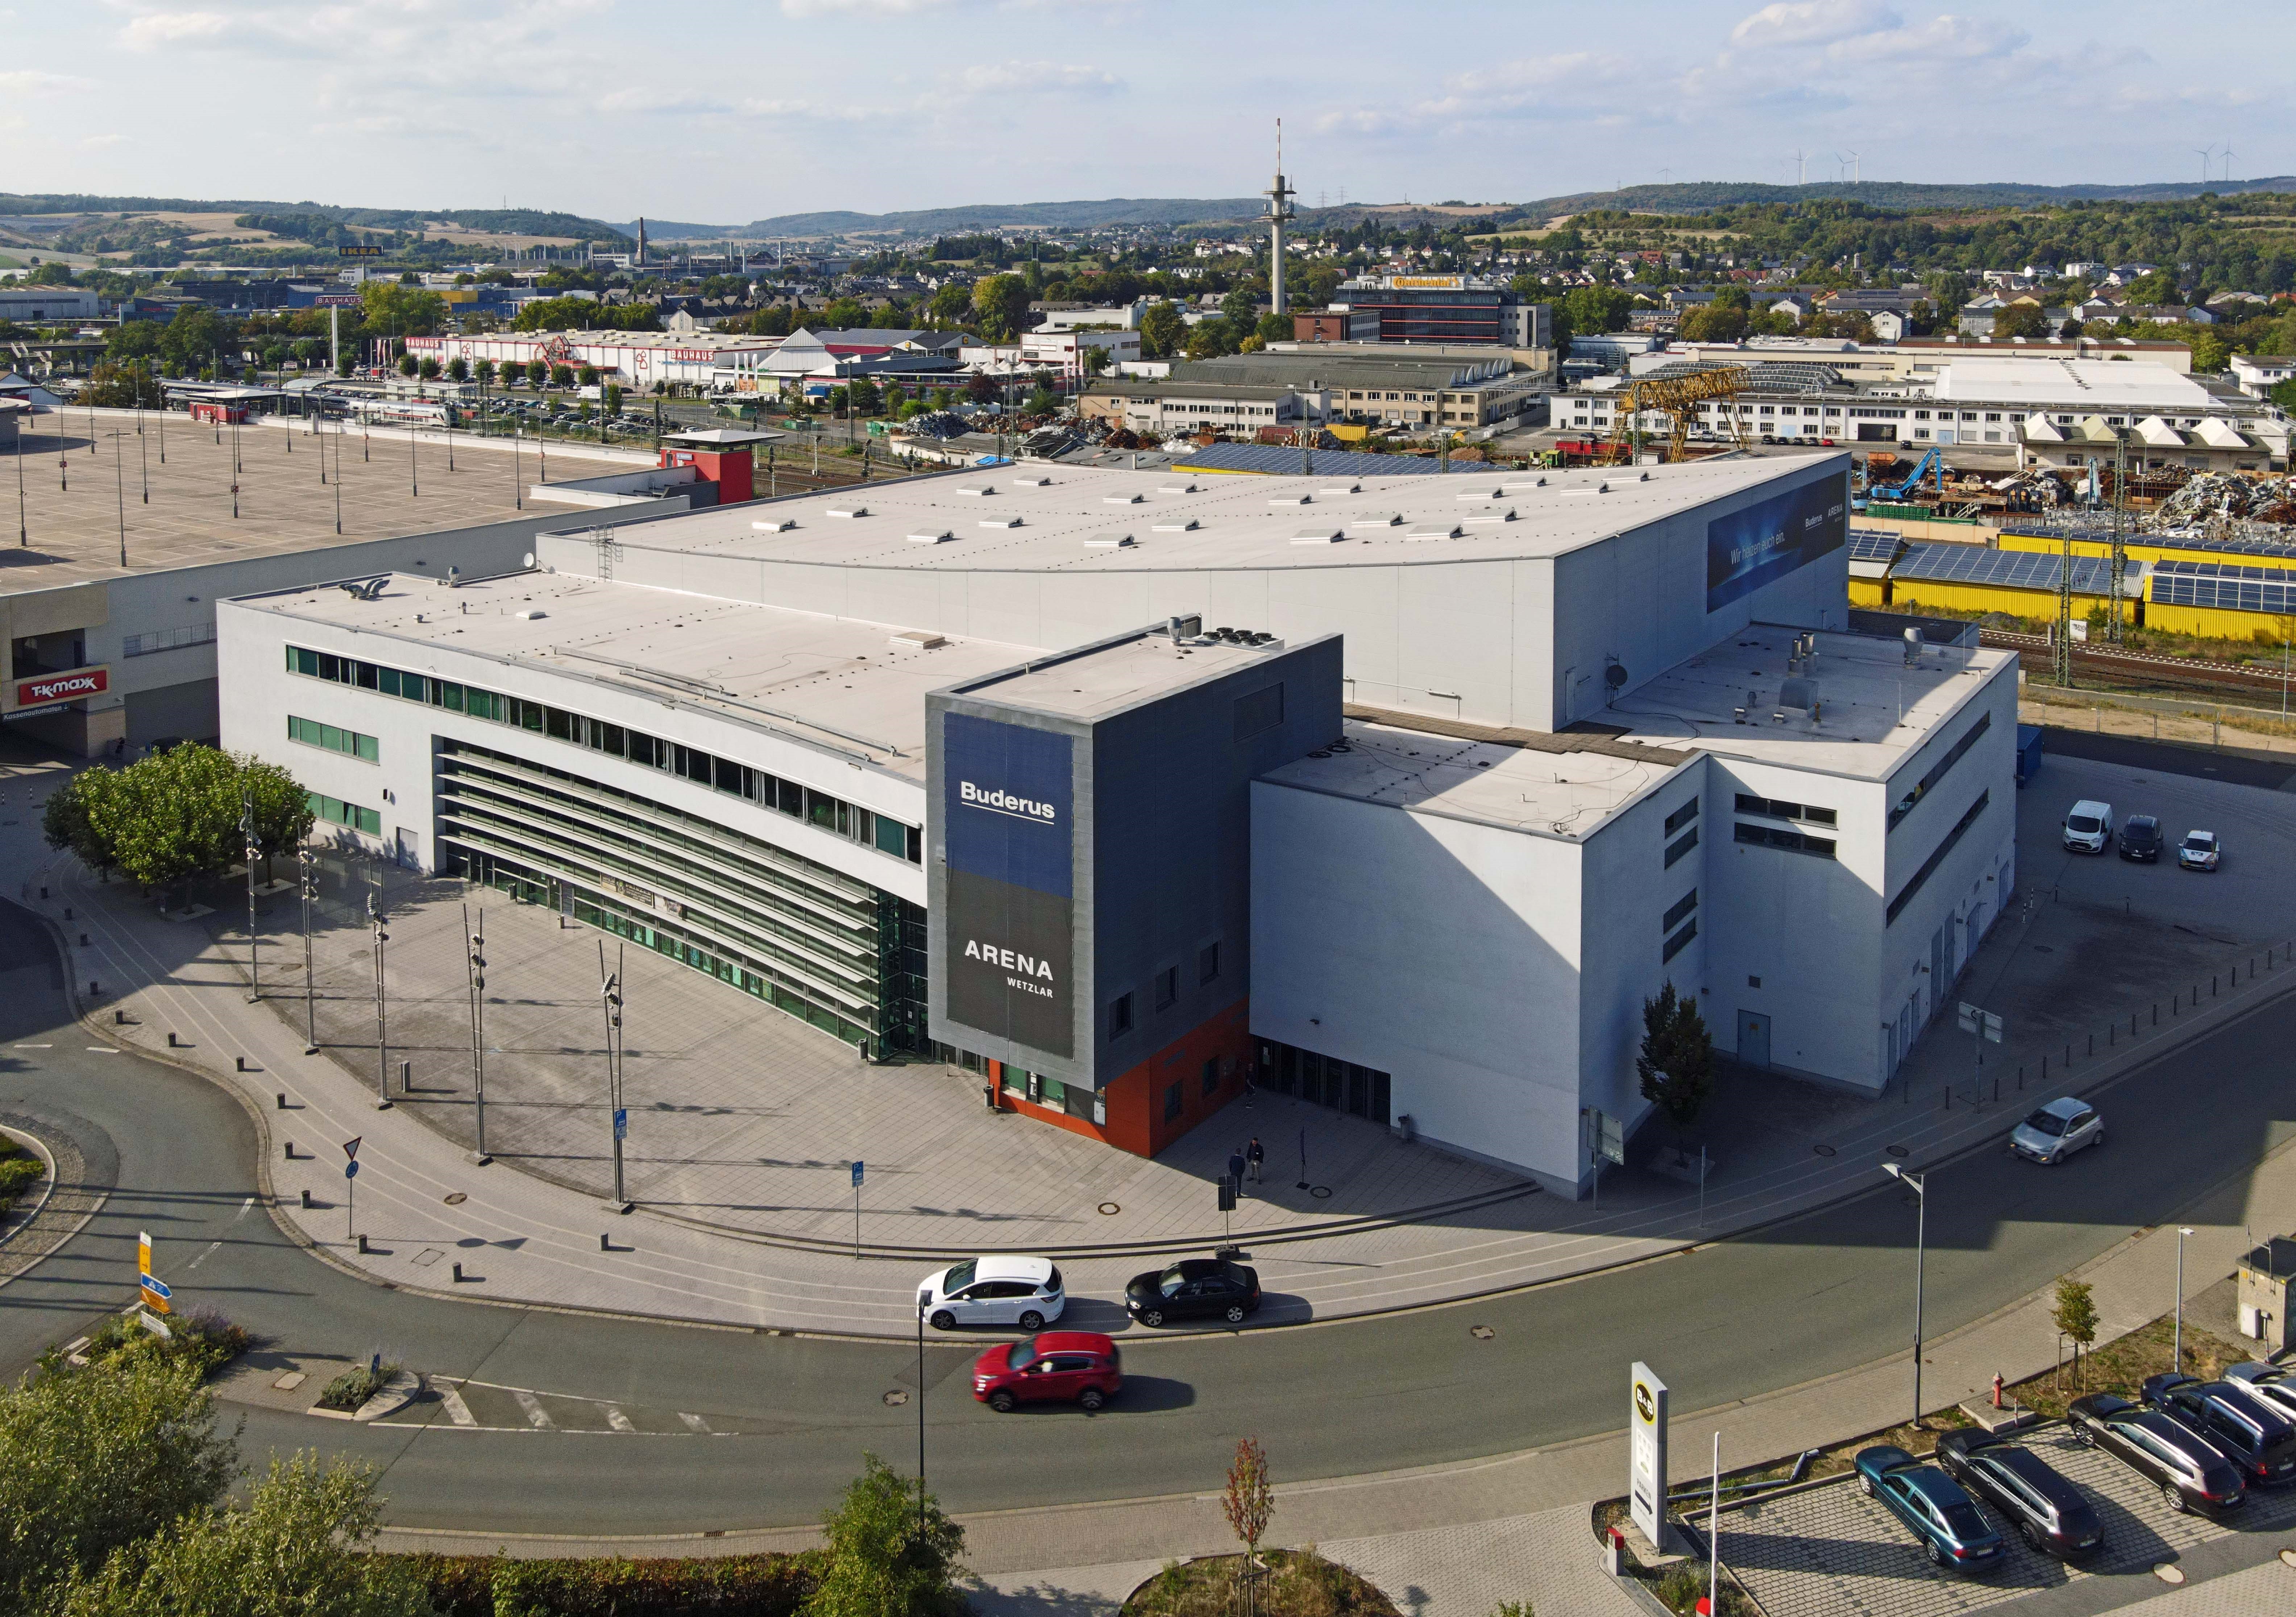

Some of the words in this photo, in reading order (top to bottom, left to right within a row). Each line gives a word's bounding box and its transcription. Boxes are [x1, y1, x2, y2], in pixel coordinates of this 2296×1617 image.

[1393, 276, 1451, 289] Continental
[406, 339, 439, 348] BAUHAUS
[672, 350, 713, 360] BAUHAUS
[1828, 503, 1842, 518] ARENA
[1806, 514, 1822, 527] Buderus
[1731, 548, 1741, 565] Wir
[1742, 543, 1760, 560] heizen
[1761, 534, 1774, 551] euch
[1776, 530, 1785, 544] ein.
[4, 706, 62, 720] Kassenautomaten
[961, 781, 1055, 818] Buderus
[965, 940, 1053, 981] ARENA
[1007, 977, 1053, 998] WETZLAR
[1637, 1388, 1653, 1415] B&B
[1637, 1478, 1651, 1500] PARKEN
